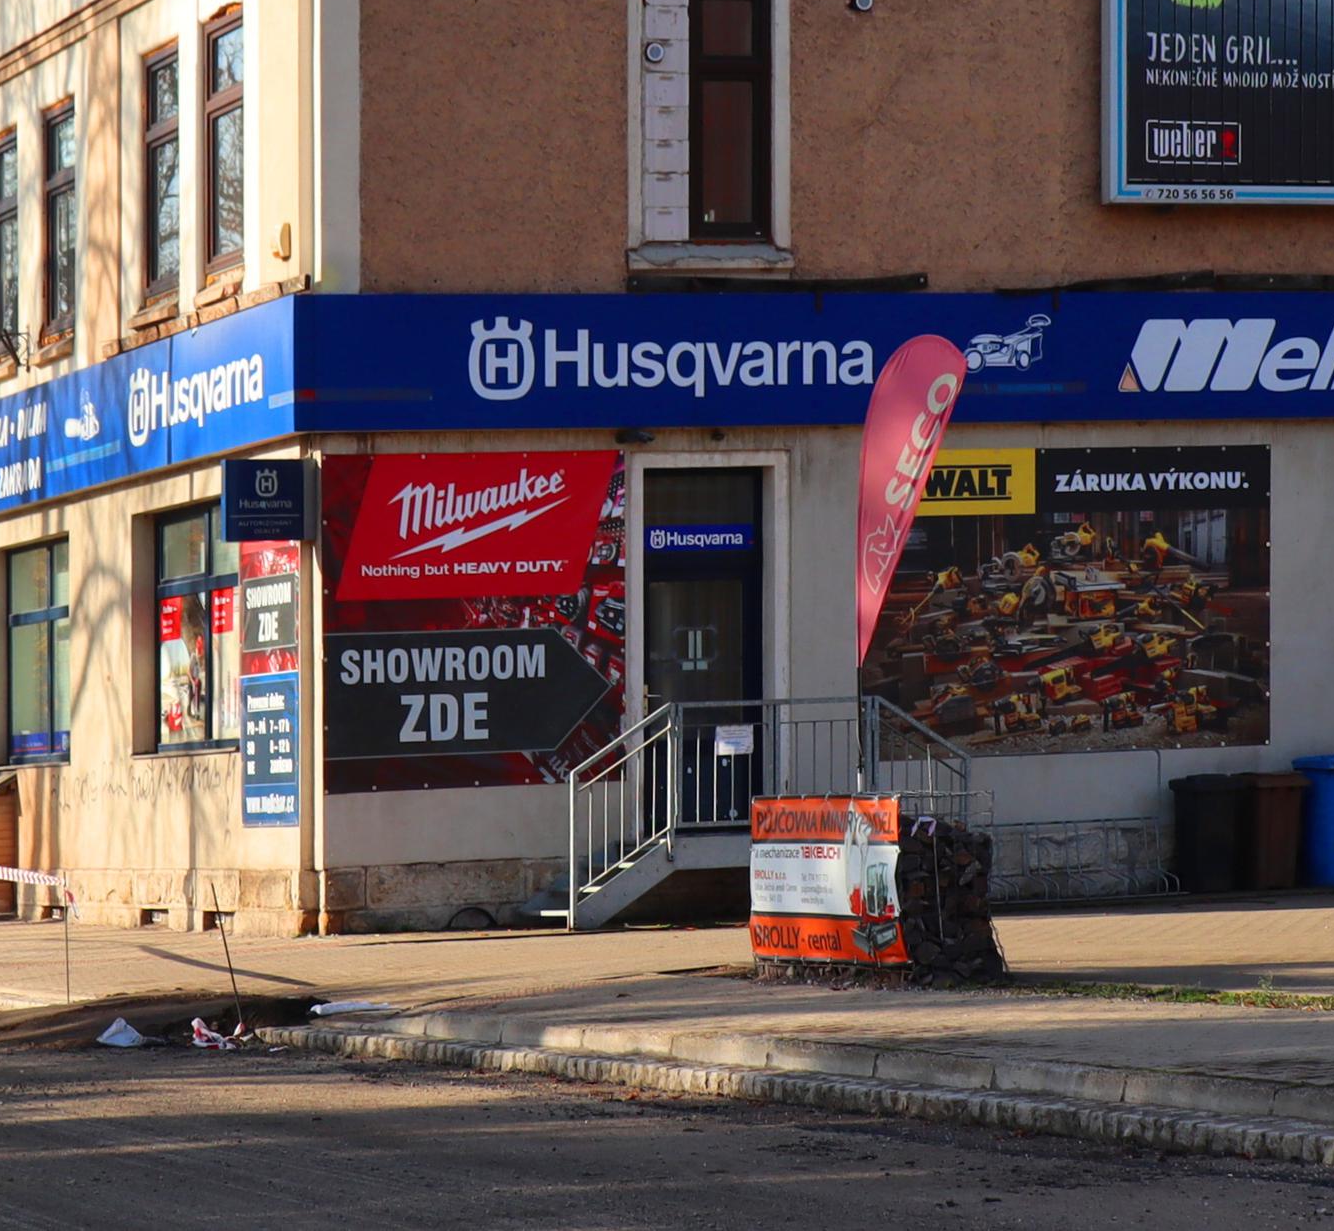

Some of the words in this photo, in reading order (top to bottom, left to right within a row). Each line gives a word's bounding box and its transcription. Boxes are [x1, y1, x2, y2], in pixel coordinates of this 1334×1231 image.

[1146, 32, 1216, 64] JEDEN
[1152, 122, 1217, 159] weber
[1157, 188, 1179, 200] 720
[1183, 188, 1197, 200] 56
[1201, 188, 1216, 200] 56
[1219, 188, 1234, 200] 56
[544, 328, 875, 398] Husqvarna
[151, 353, 264, 430] Husqvarna
[884, 372, 958, 512] SECO
[921, 469, 1012, 498] WALT
[1054, 469, 1147, 492] ZÁRUKA
[1149, 467, 1250, 491] VÝKONU.
[238, 498, 293, 510] Husqvarna
[387, 468, 566, 541] Milwaukee
[666, 531, 744, 548] Husqvarna
[360, 564, 420, 578] Nothing
[424, 564, 449, 576] but
[453, 561, 512, 574] HEAVY
[516, 560, 564, 573] DUTY.
[245, 581, 292, 610] SHOWROOM
[258, 611, 279, 643] ZDE
[340, 644, 546, 685] SHOWROOM
[399, 692, 490, 743] ZDE
[756, 805, 818, 834] PŮJČOVNA
[754, 924, 800, 949] BROLLY
[808, 929, 842, 951] rental
